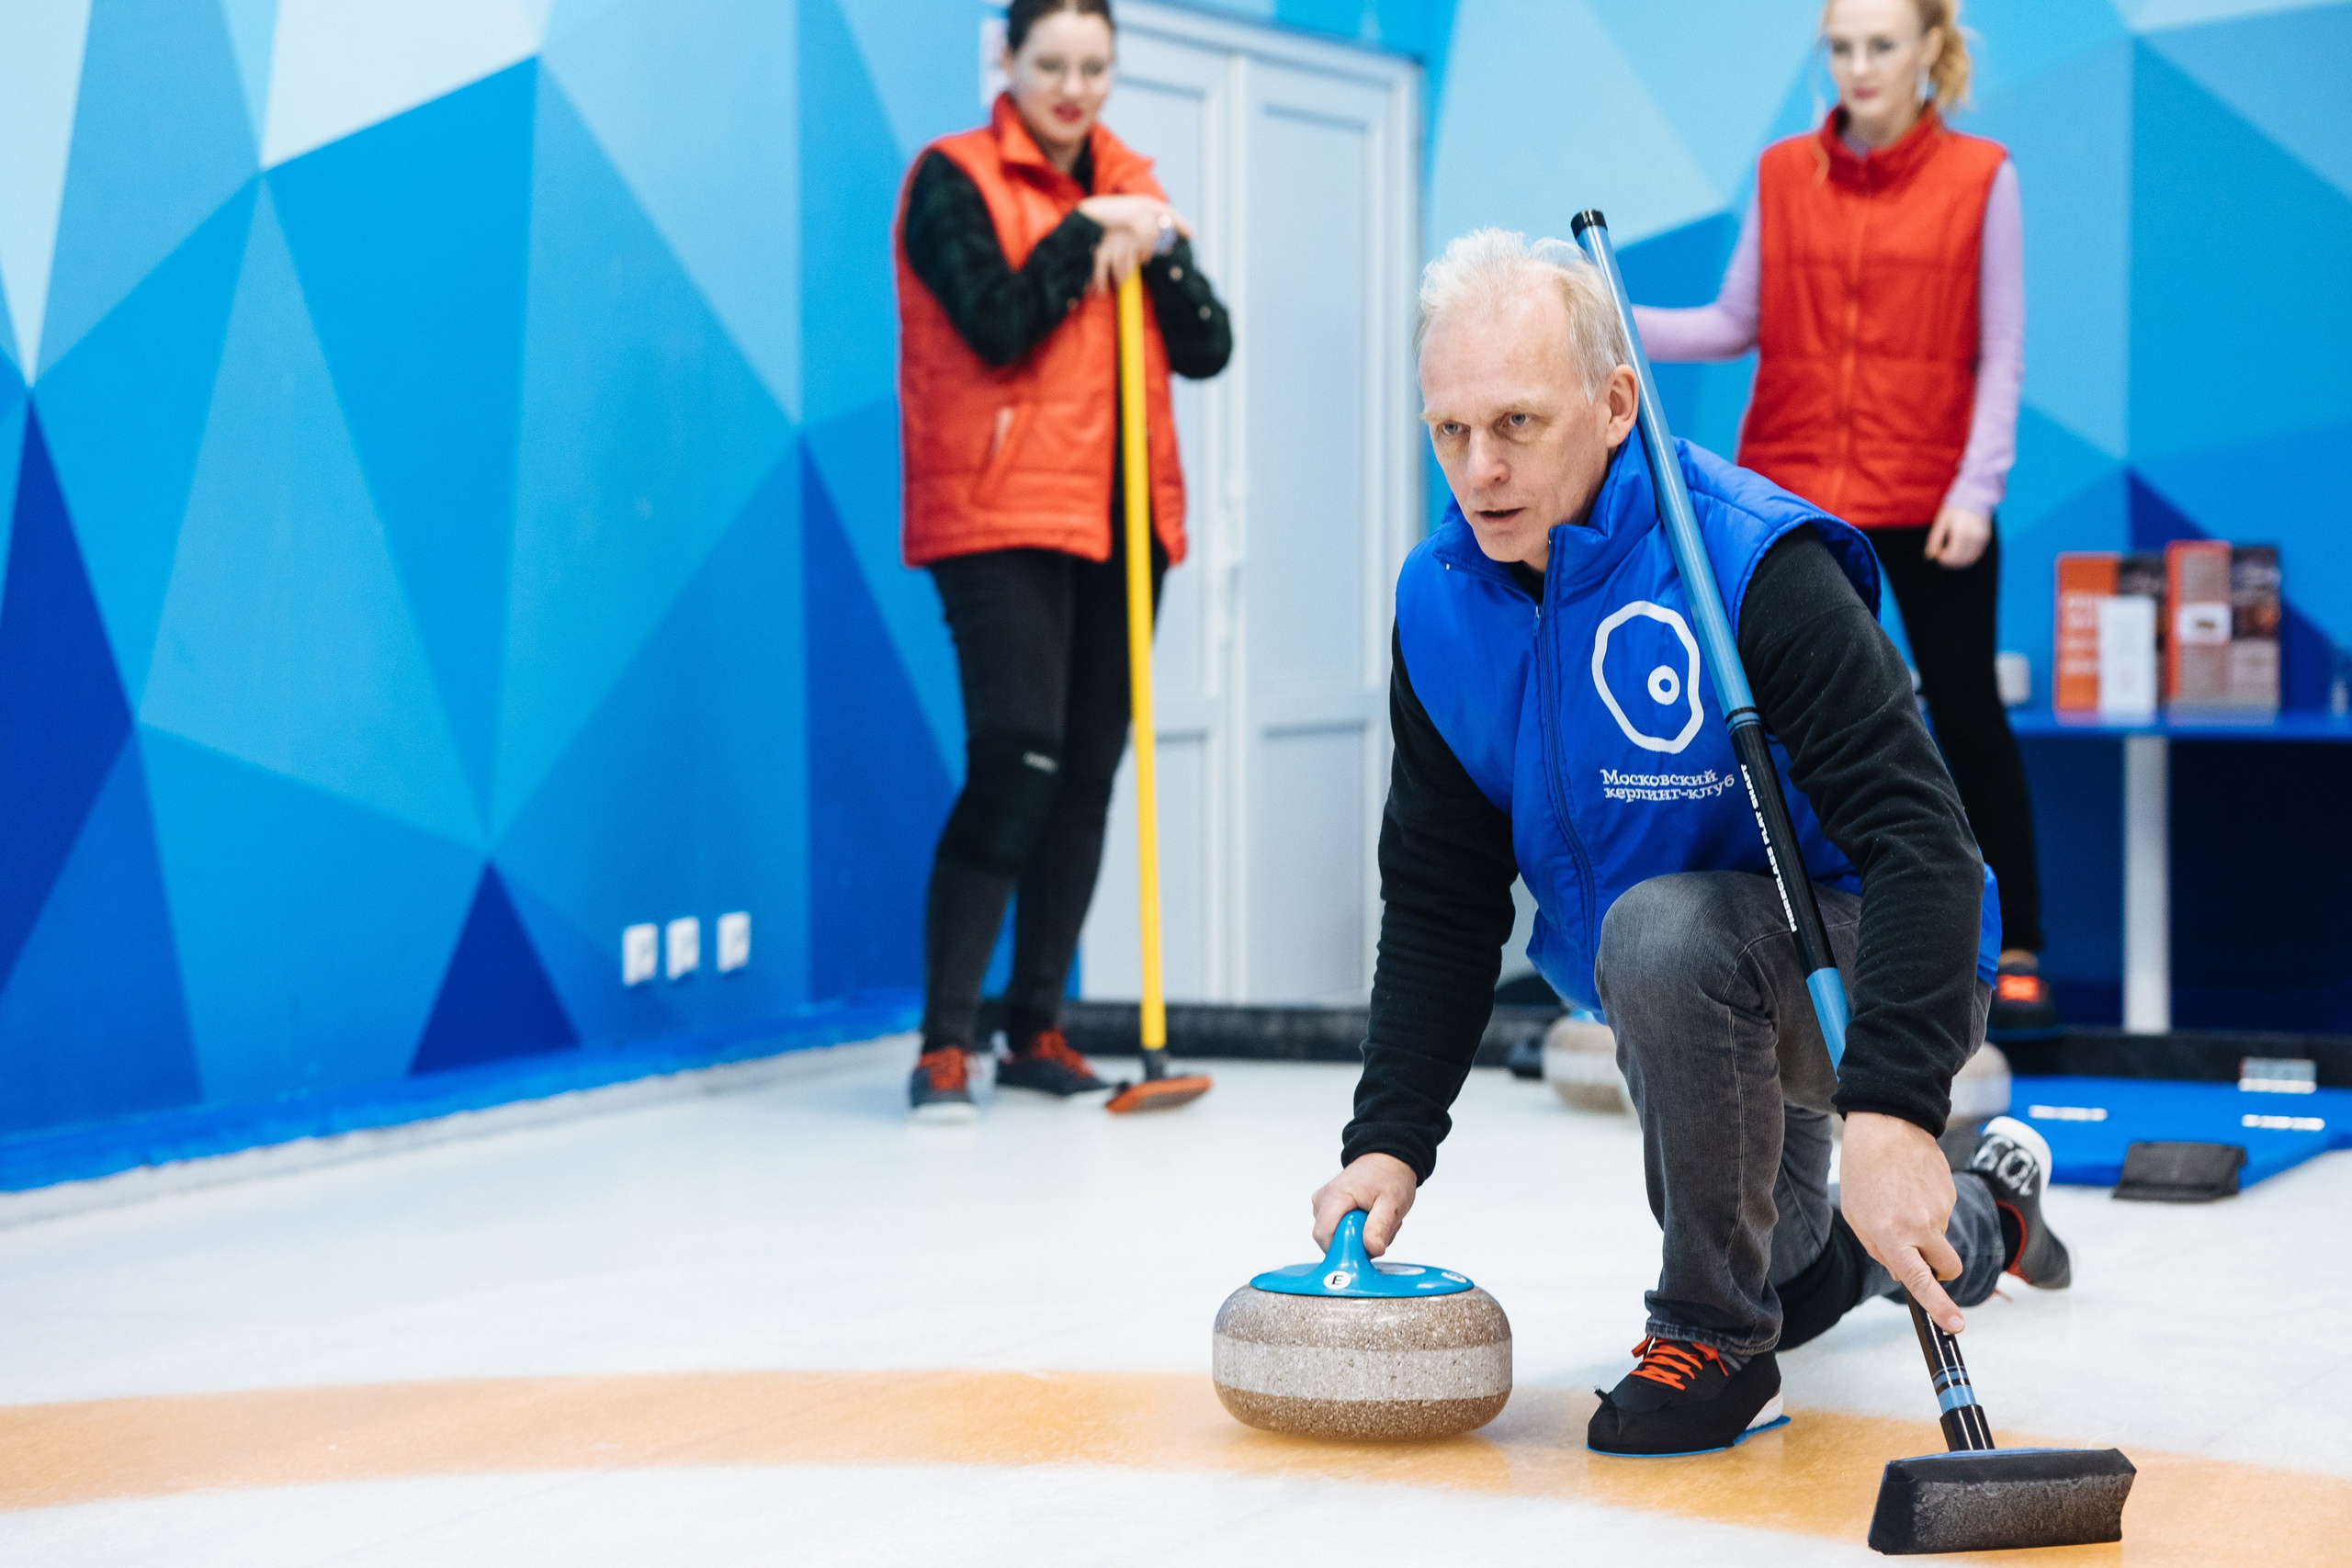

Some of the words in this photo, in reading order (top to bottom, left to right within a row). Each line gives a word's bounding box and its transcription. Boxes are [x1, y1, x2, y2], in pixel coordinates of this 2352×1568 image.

[1600, 769, 1719, 787] Московский
[1604, 774, 1735, 803] керлинг-клуб
[1740, 763, 1759, 809] SHAFT
[1756, 811, 1770, 845] FLAT
[1332, 1275, 1344, 1285] E
